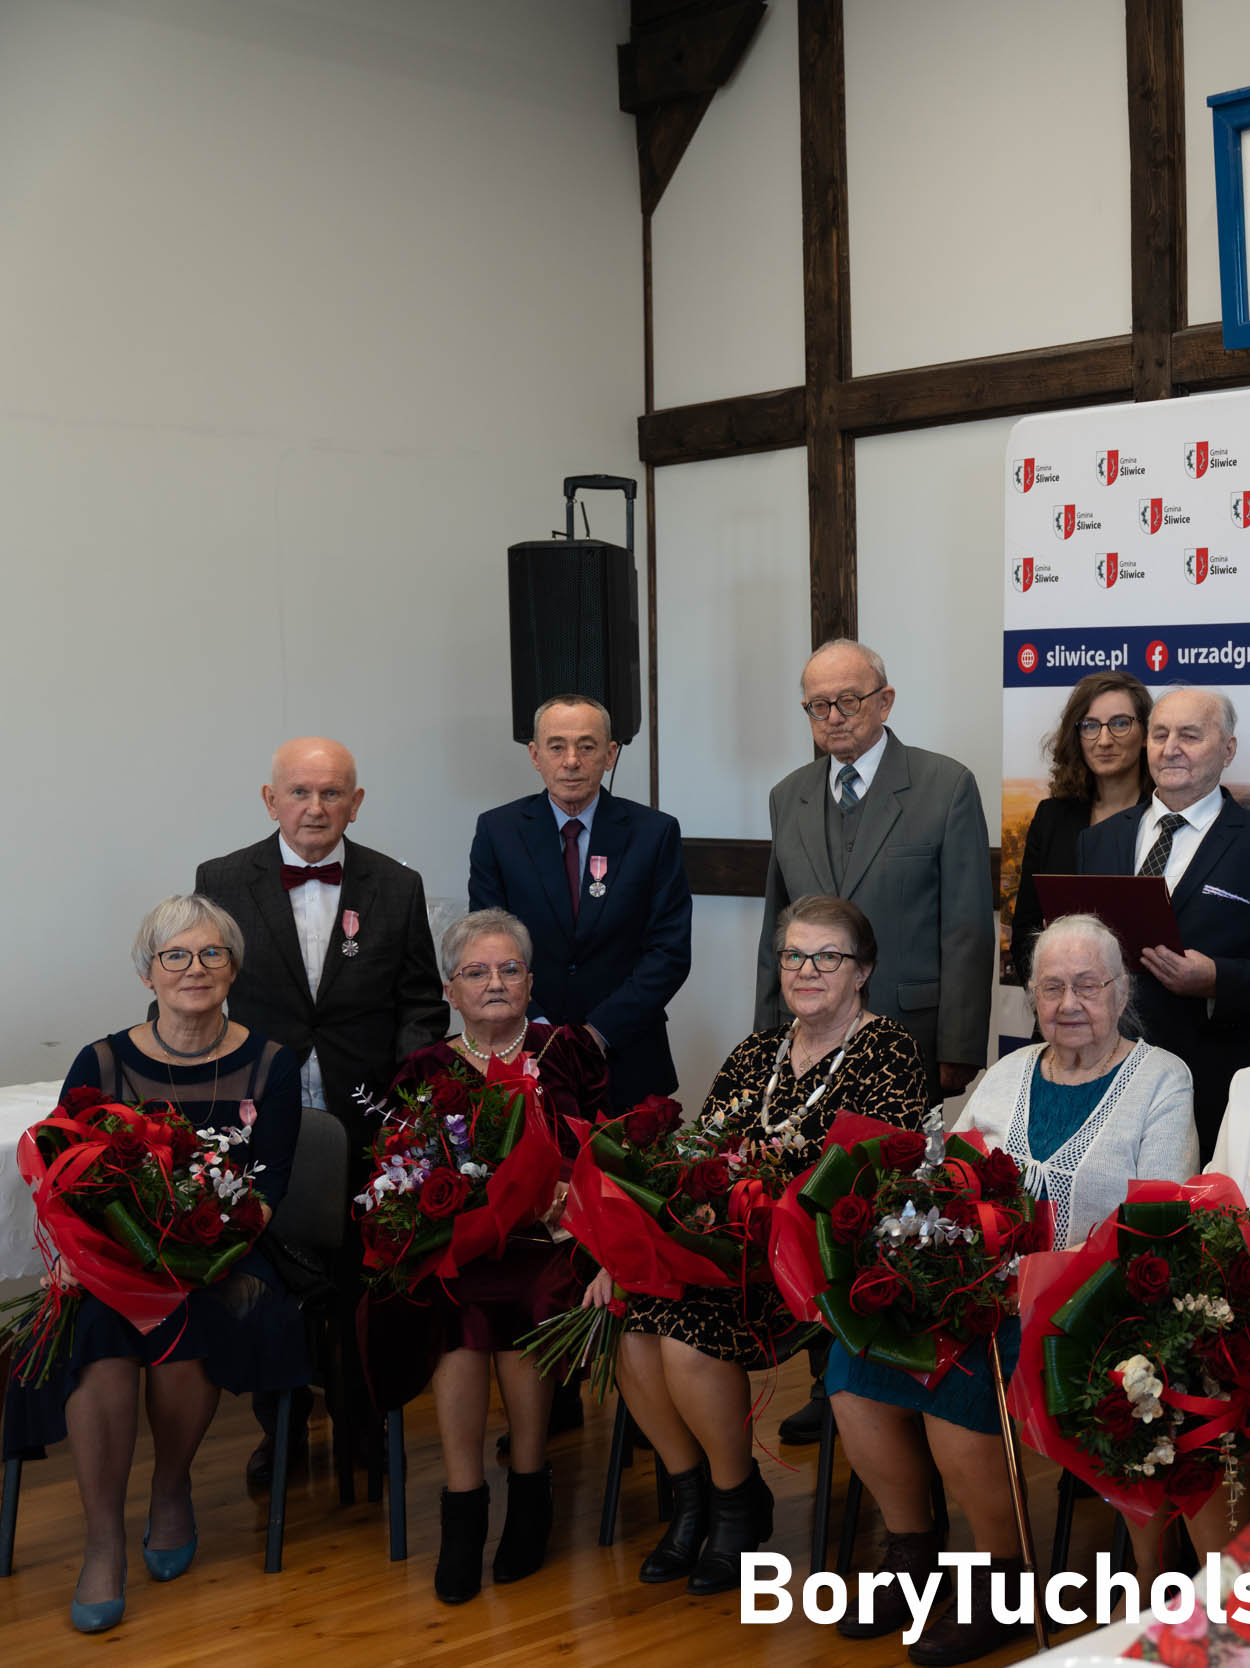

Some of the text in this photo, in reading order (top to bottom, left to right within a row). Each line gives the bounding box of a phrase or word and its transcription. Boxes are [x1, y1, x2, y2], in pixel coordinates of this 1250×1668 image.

[1210, 456, 1237, 469] Śliwice
[1120, 464, 1146, 477] Śliwice
[1036, 472, 1060, 484] Śliwice
[1076, 520, 1101, 530] Śliwice
[1164, 514, 1190, 526] Śliwice
[1119, 568, 1145, 580] Śliwice
[1210, 564, 1237, 576] Śliwice
[1034, 573, 1058, 584] Śliwice
[1046, 643, 1128, 667] sliwice.pl
